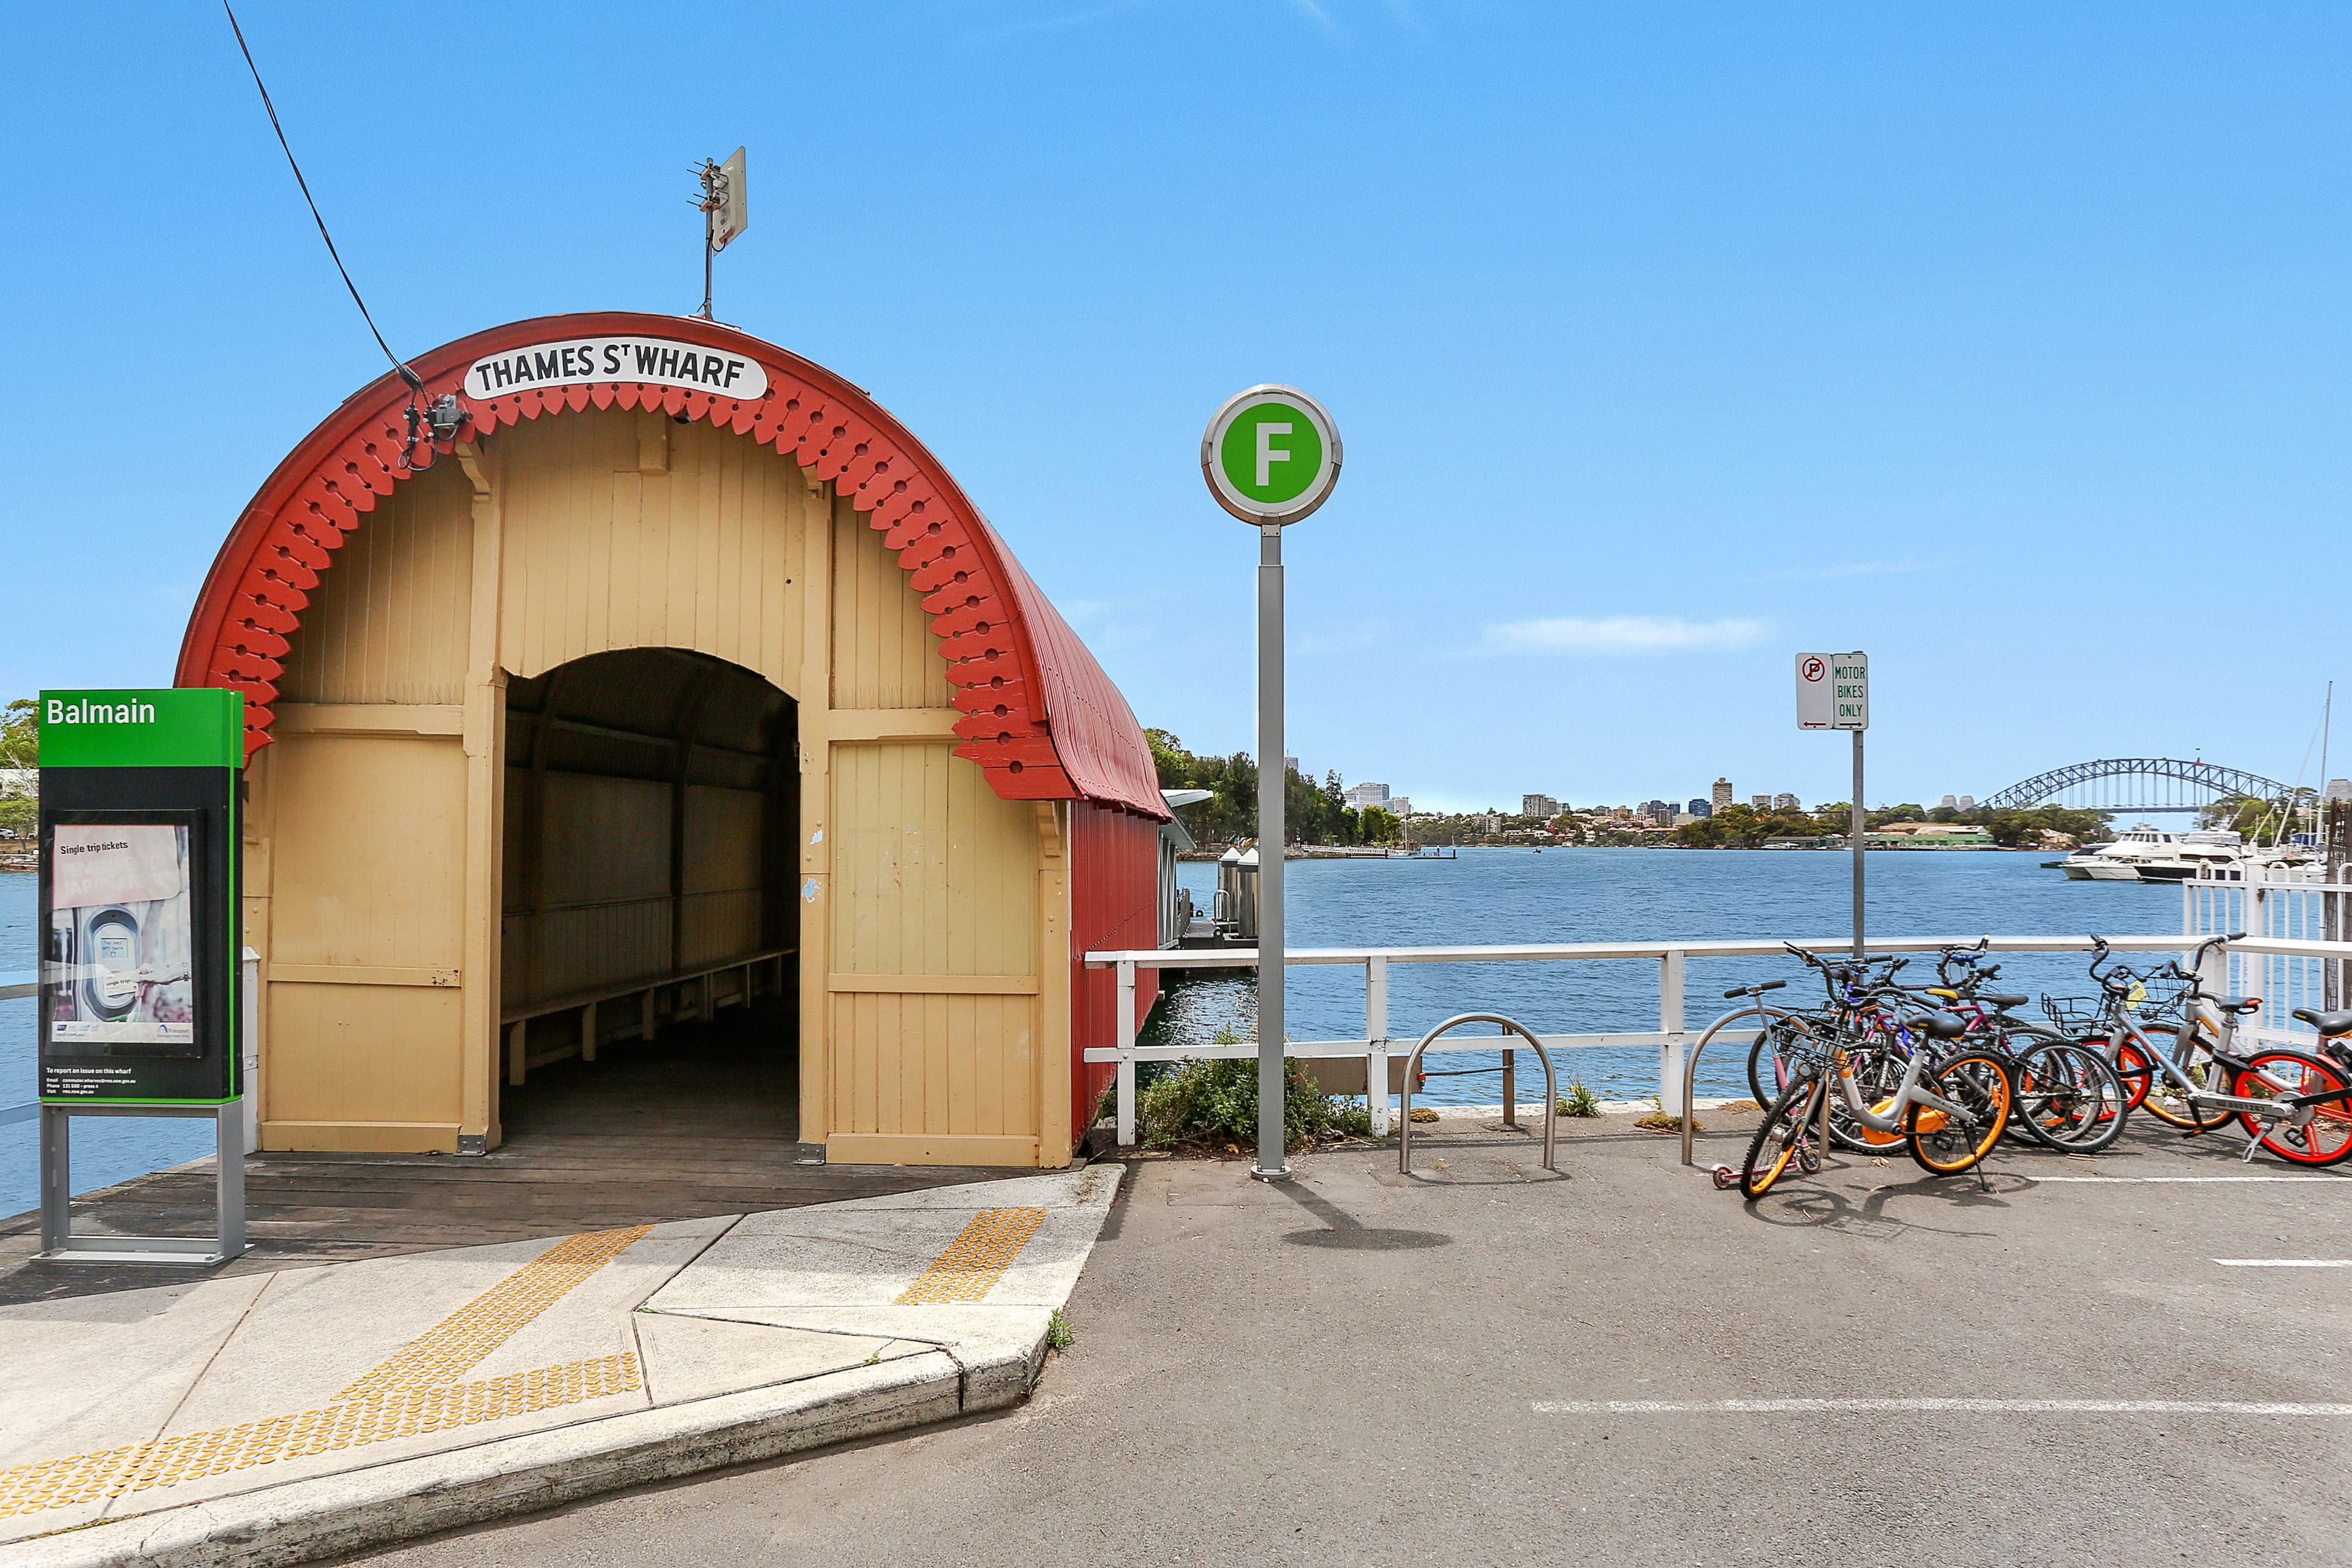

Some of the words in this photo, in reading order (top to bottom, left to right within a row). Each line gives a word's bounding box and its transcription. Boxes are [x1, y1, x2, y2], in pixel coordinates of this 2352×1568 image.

[476, 345, 594, 391] THAMES
[635, 345, 745, 388] WHARF
[1256, 422, 1292, 486] F
[1809, 663, 1820, 677] P
[1834, 666, 1866, 679] MOTOR
[1838, 685, 1863, 698] BIKES
[47, 698, 155, 724] Balmain
[1839, 704, 1863, 717] ONLY
[60, 846, 85, 855] Single
[87, 843, 101, 853] trip
[102, 841, 129, 850] tickets
